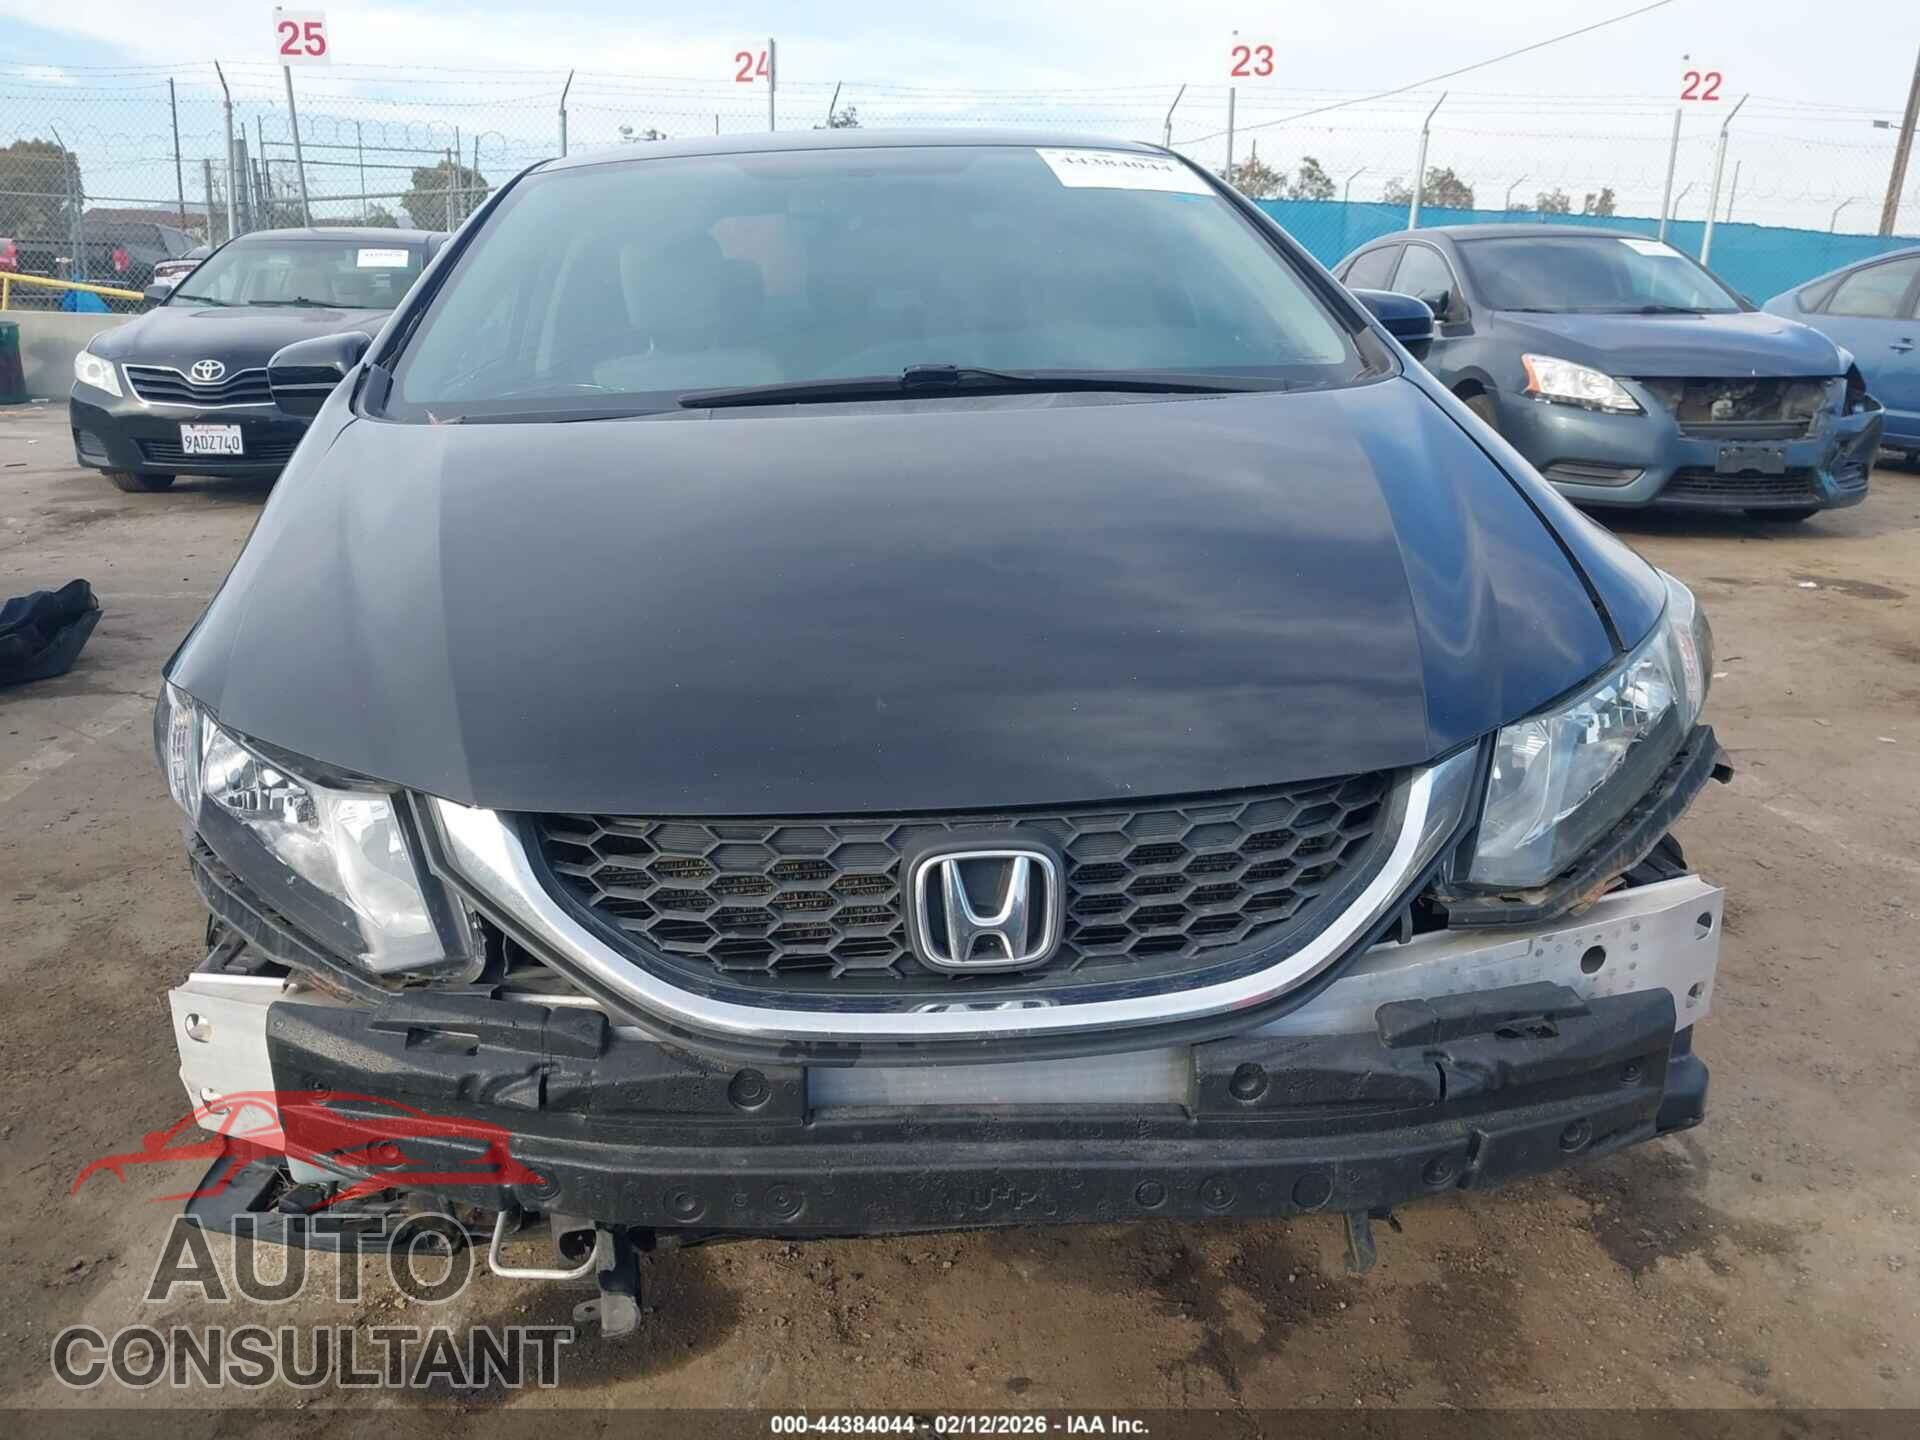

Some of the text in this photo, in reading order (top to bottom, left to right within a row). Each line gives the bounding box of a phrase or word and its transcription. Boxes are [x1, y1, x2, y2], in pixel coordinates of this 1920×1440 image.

[278, 21, 326, 56] 25
[1231, 45, 1274, 77] 23
[1680, 71, 1721, 100] 22
